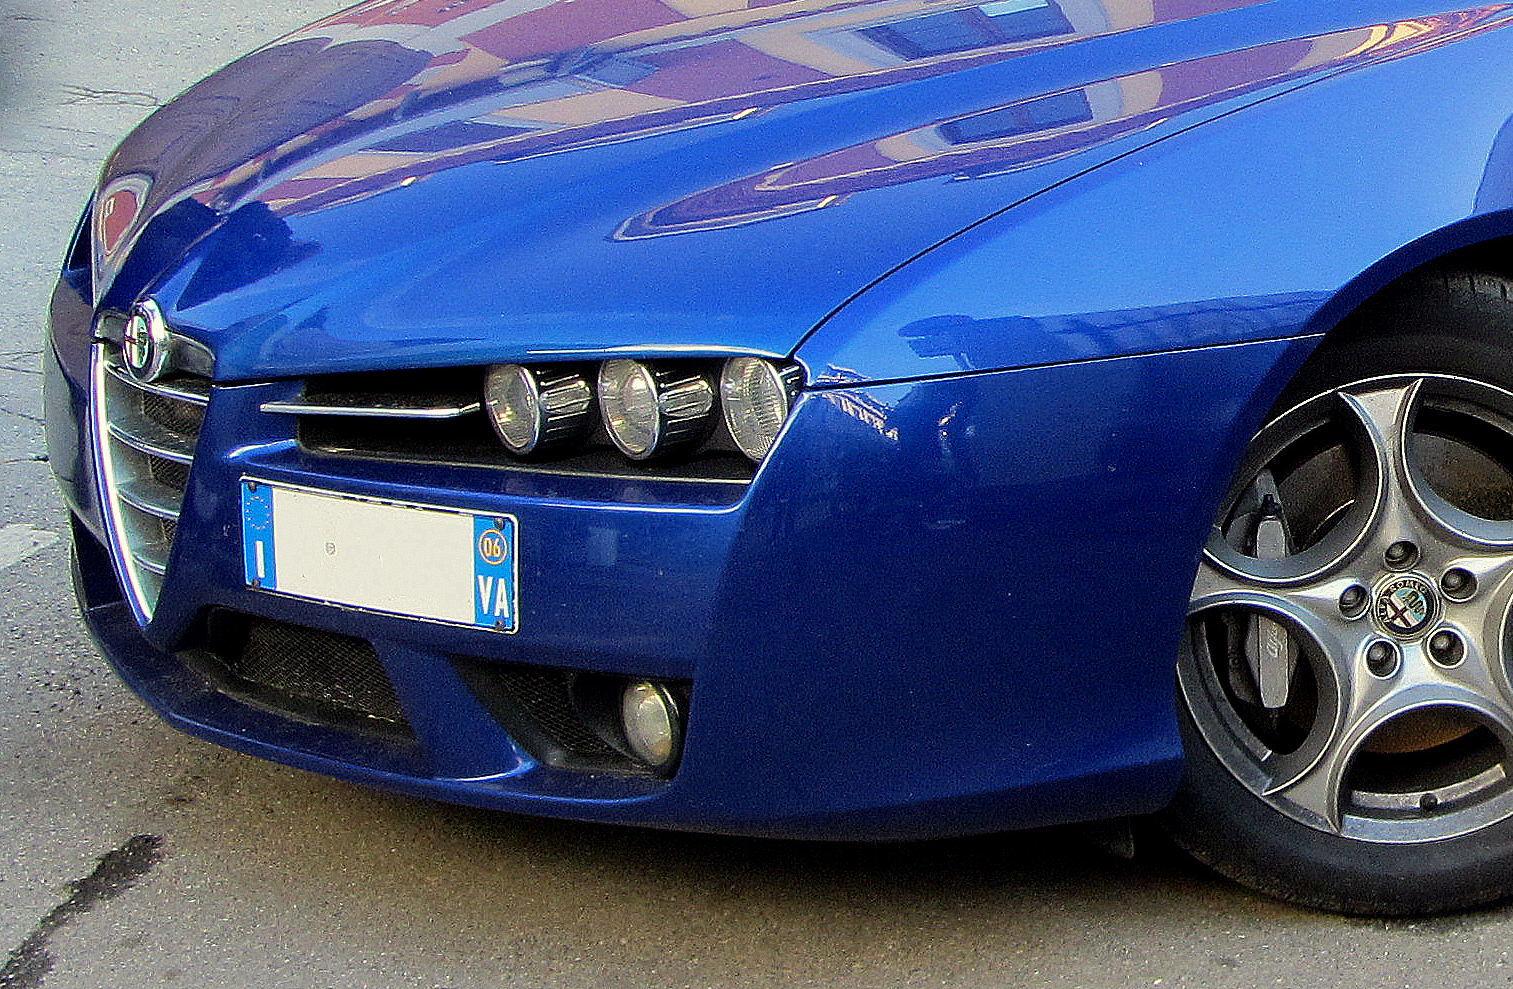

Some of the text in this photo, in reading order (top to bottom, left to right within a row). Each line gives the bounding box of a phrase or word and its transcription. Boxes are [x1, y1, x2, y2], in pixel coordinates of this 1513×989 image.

[256, 540, 266, 579] I
[484, 537, 501, 558] 06
[477, 574, 510, 619] VA
